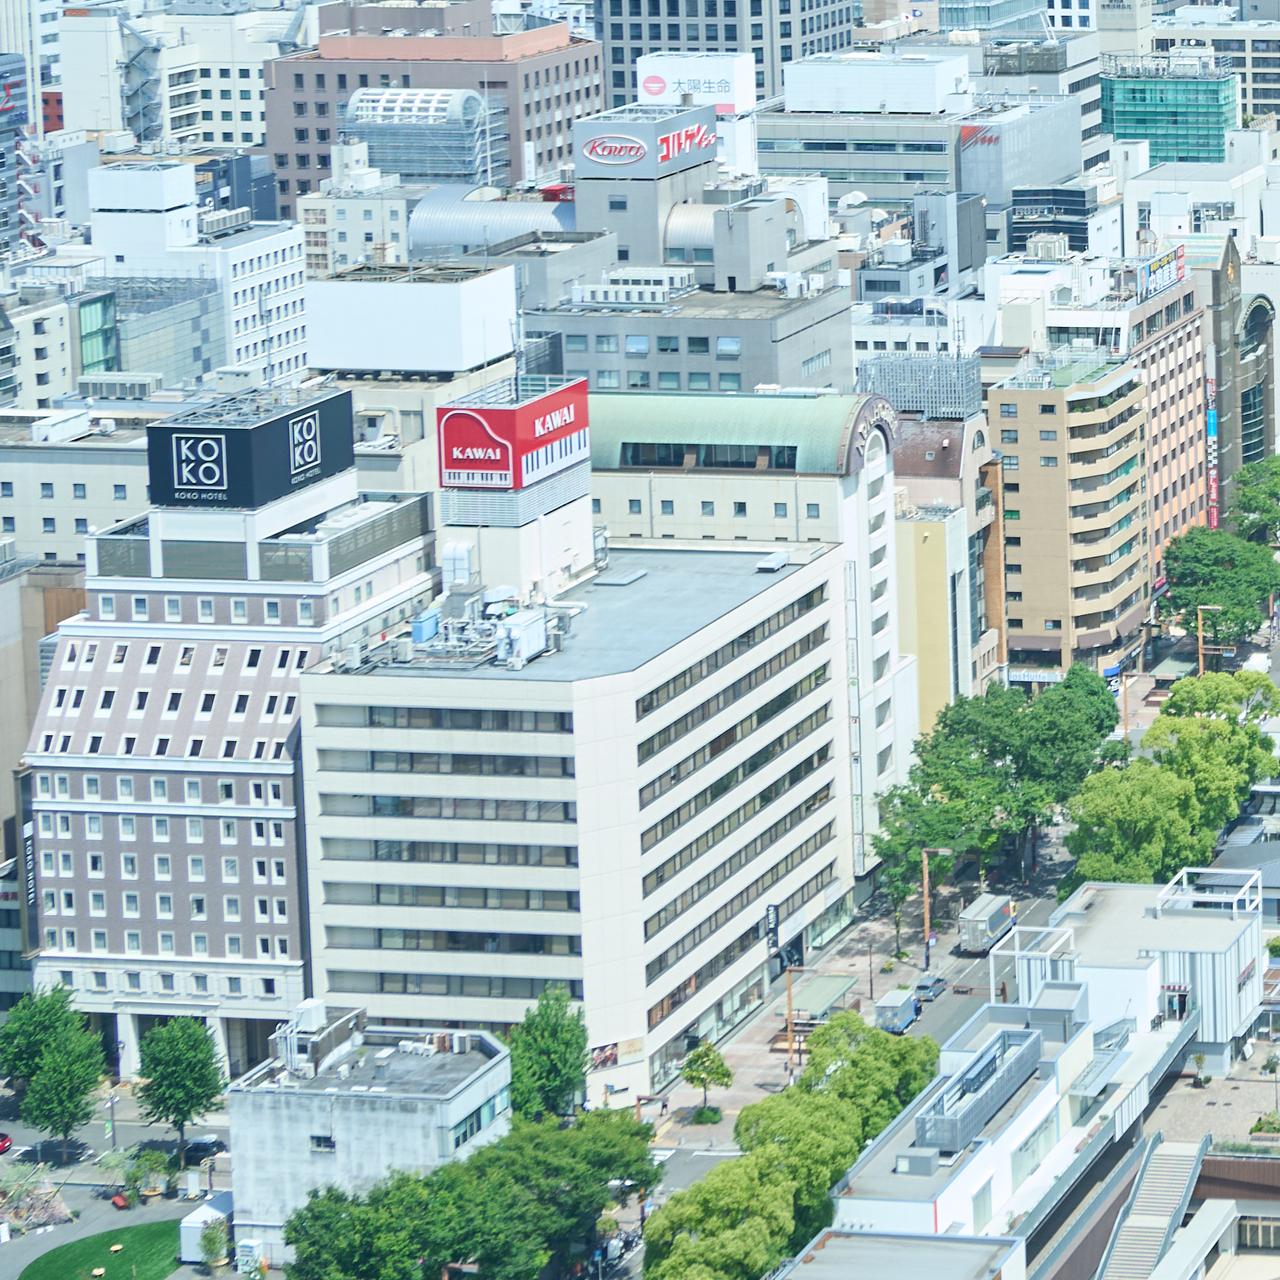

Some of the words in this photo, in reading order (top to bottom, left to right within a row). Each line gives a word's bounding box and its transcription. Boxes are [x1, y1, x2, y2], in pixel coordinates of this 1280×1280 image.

[672, 79, 731, 94] 太陽生命
[588, 139, 644, 157] Kowa
[294, 417, 316, 444] KO
[534, 404, 575, 438] KAWAI
[181, 438, 219, 461] KO
[295, 440, 317, 467] KO
[452, 447, 500, 460] KAWAI
[182, 462, 220, 485] KO
[291, 474, 305, 484] KOKO
[305, 468, 321, 480] HOTEL
[174, 492, 199, 500] KOKO
[201, 492, 228, 501] HOTEL
[27, 871, 35, 906] HOTEL
